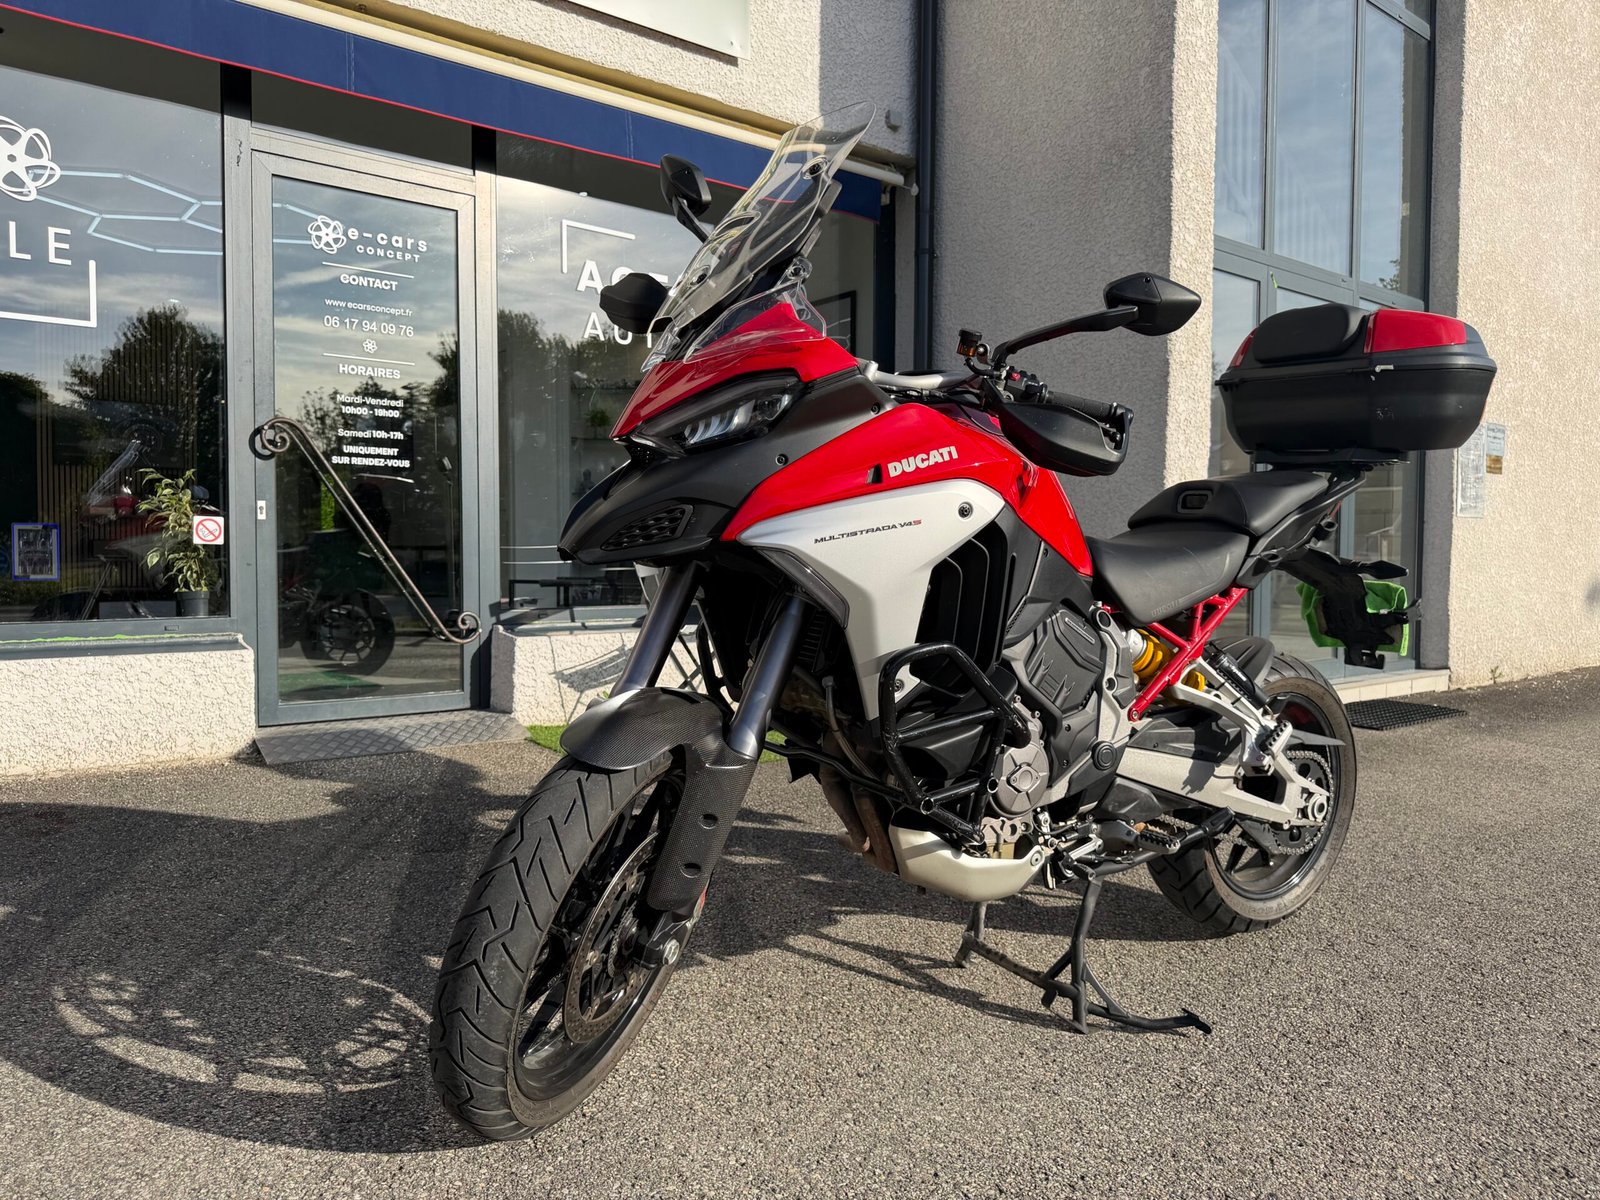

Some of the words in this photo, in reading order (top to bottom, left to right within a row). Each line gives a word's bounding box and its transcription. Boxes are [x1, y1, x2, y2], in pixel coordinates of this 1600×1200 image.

[348, 227, 428, 252] e-cars
[356, 245, 421, 263] CONCEPT
[340, 273, 398, 291] CONTACT
[324, 298, 413, 317] wwwecarsconcept.fr
[323, 315, 340, 328] 06
[344, 318, 359, 330] 17
[362, 320, 378, 333] 94
[380, 322, 396, 335] 09
[399, 325, 414, 337] 76
[339, 363, 401, 379] HORAIRES
[336, 394, 404, 408] Mardi-Vendredi
[341, 405, 368, 415] 10h00
[374, 408, 400, 418] 19h00
[337, 428, 372, 439] Samedi
[372, 429, 404, 440] 10h-17h
[342, 445, 399, 456] UNIQUEMENT
[331, 455, 350, 464] SUR
[351, 456, 411, 468] RENDEZ-VOUS
[887, 445, 959, 478] DUCATI
[813, 523, 899, 544] MULTISTRADA
[898, 519, 922, 529] V4S
